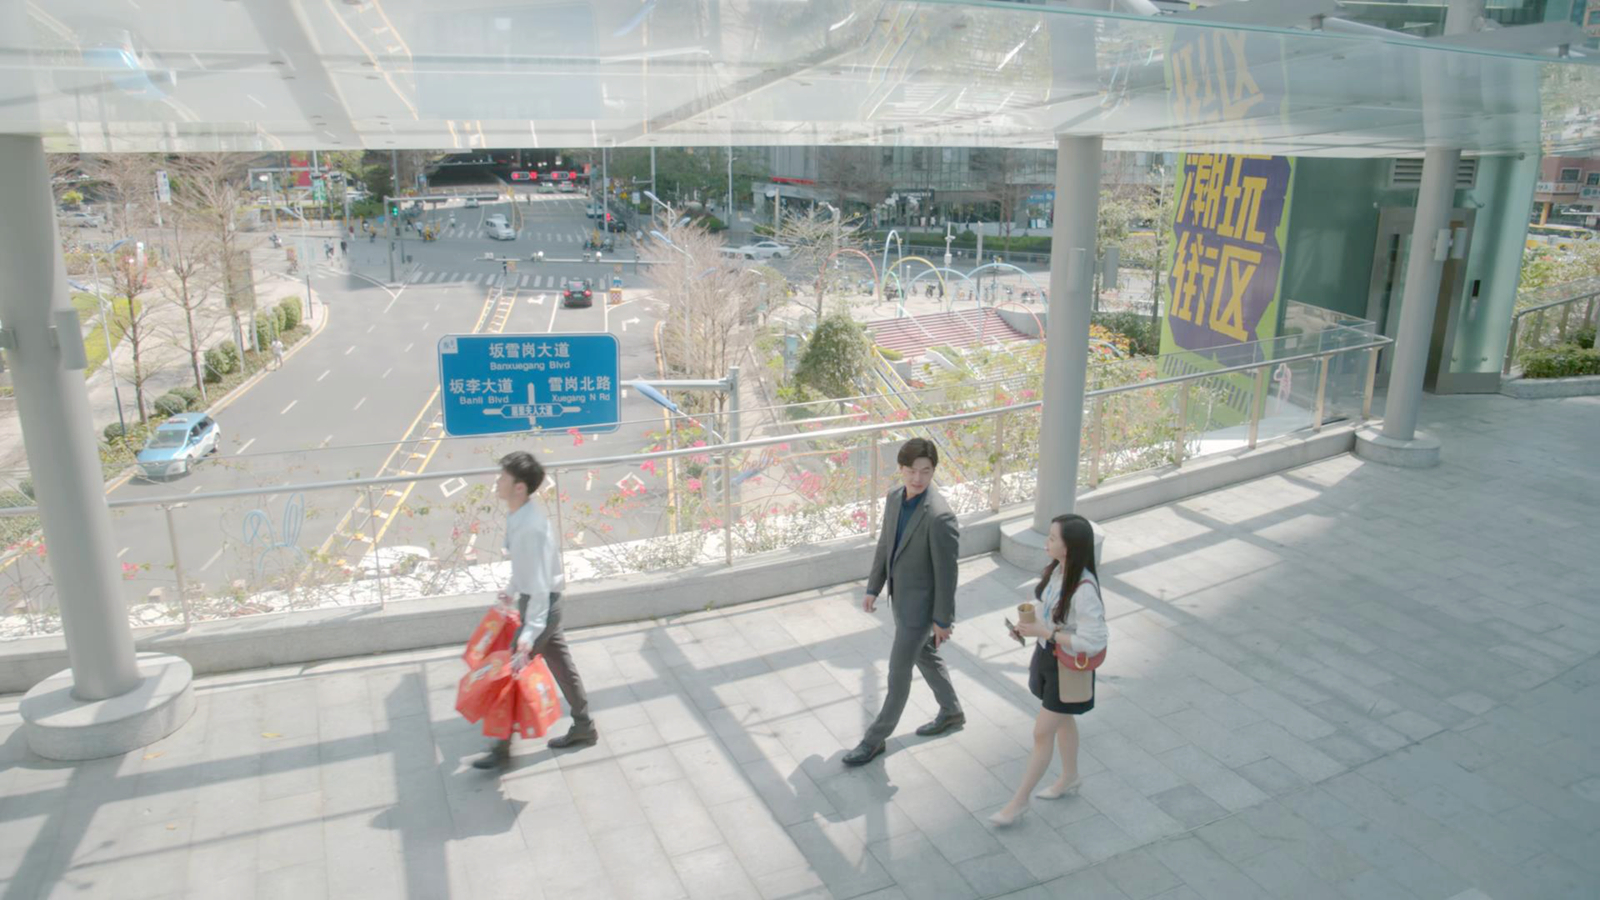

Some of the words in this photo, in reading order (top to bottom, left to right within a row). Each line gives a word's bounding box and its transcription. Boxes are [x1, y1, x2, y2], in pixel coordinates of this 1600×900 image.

[1176, 153, 1272, 244] 潮玩
[1170, 231, 1262, 342] 街区
[489, 342, 570, 358] 坂雪岗大道
[490, 362, 545, 371] Banxuegang
[549, 361, 570, 369] Blvd
[449, 378, 513, 394] 坂李大道
[548, 376, 610, 392] 雪岗北路
[460, 396, 483, 405] Banli
[488, 395, 509, 404] Blvd
[552, 394, 586, 403] Xuegang
[589, 393, 596, 401] N
[599, 393, 610, 401] Rd
